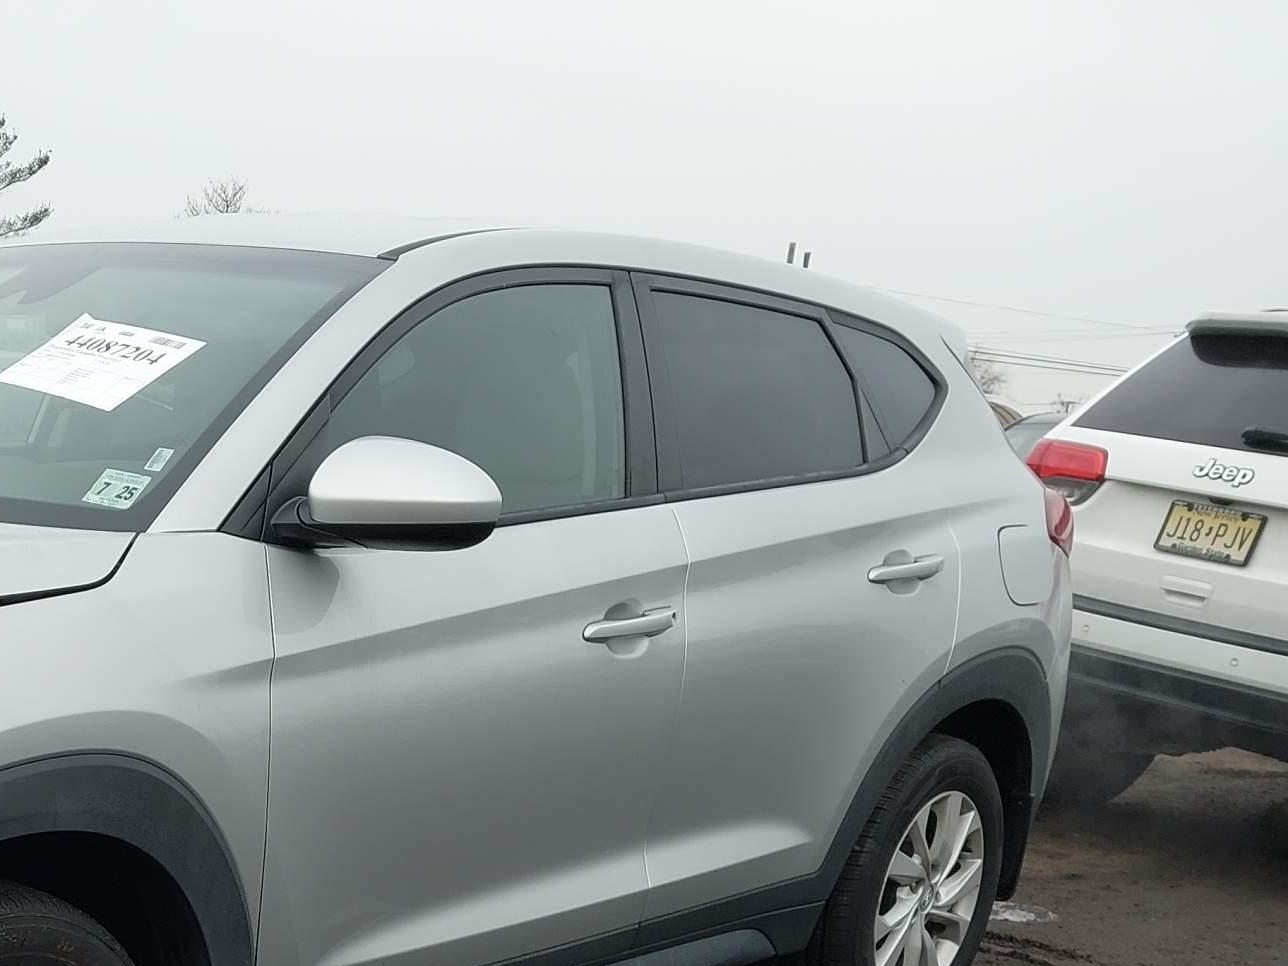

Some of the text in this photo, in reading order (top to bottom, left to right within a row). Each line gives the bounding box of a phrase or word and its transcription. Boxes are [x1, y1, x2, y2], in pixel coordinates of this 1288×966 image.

[64, 334, 168, 365] 44087204
[1193, 458, 1254, 487] Jeep
[97, 482, 138, 500] 7 25
